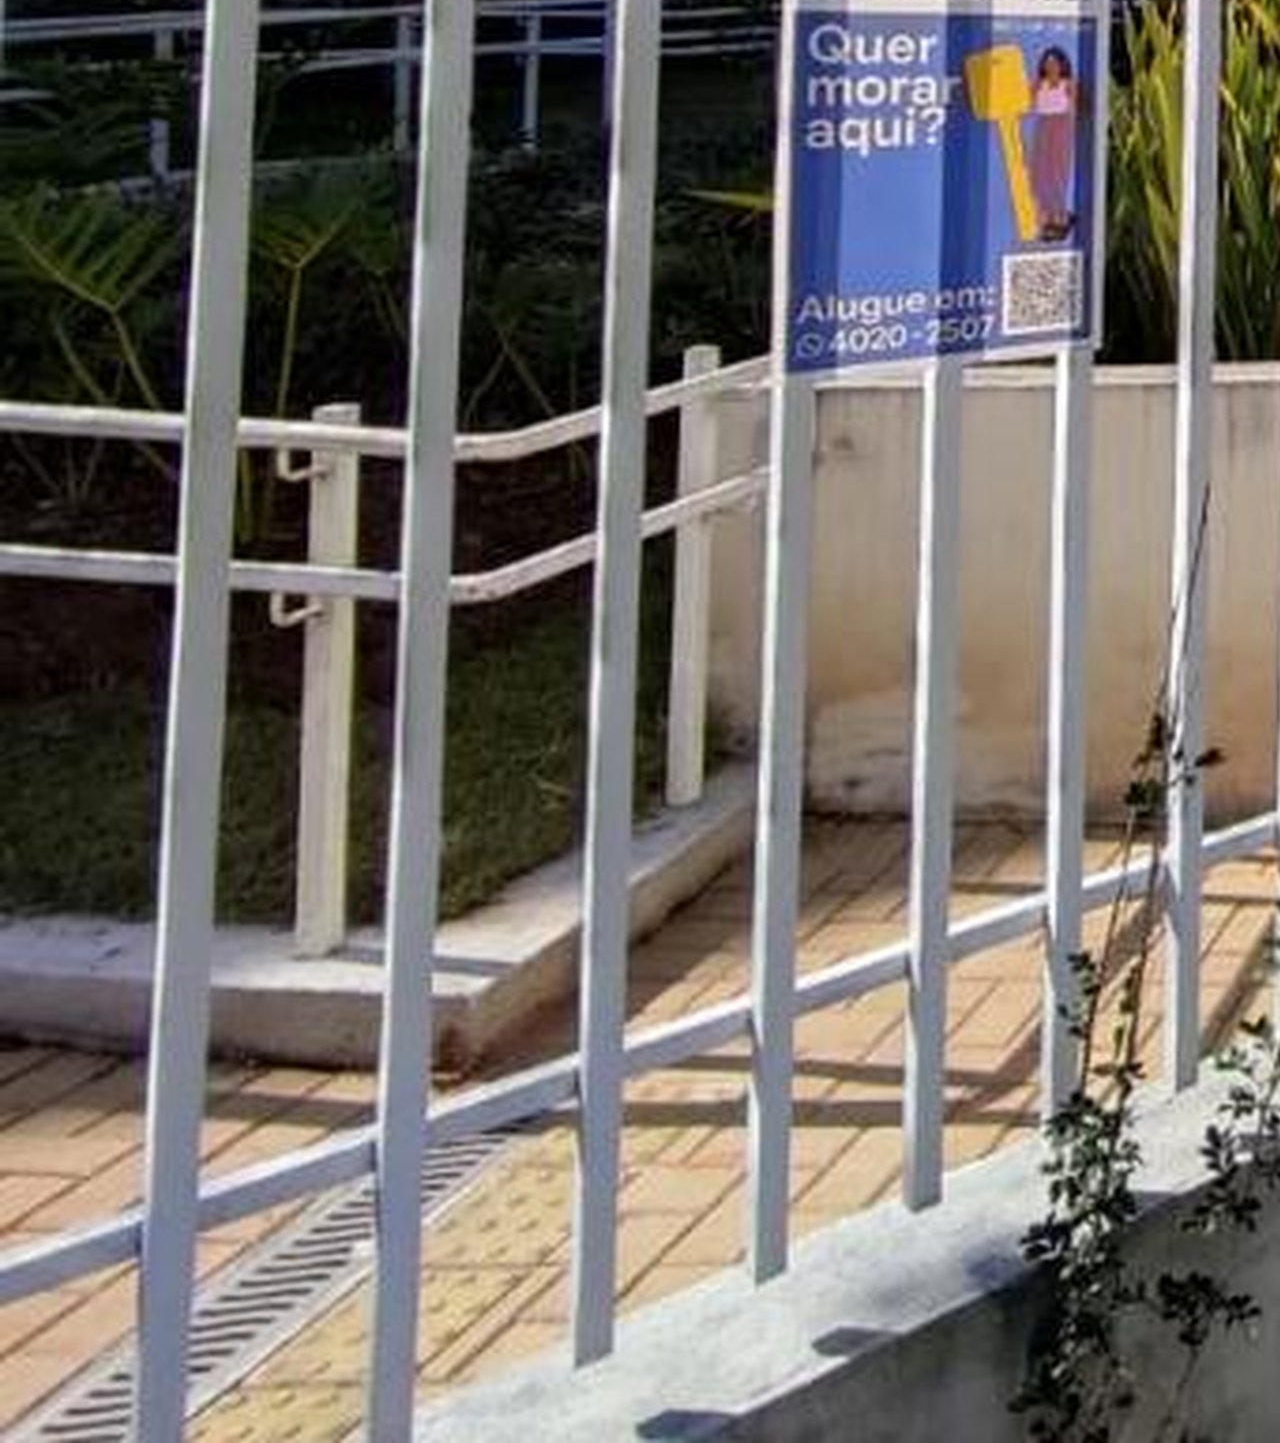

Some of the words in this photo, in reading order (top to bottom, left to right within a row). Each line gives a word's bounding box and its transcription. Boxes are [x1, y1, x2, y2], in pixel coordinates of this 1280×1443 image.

[808, 24, 938, 65] Quer
[808, 73, 962, 107] morar
[806, 108, 946, 156] aqui?
[796, 290, 927, 327] Alugue
